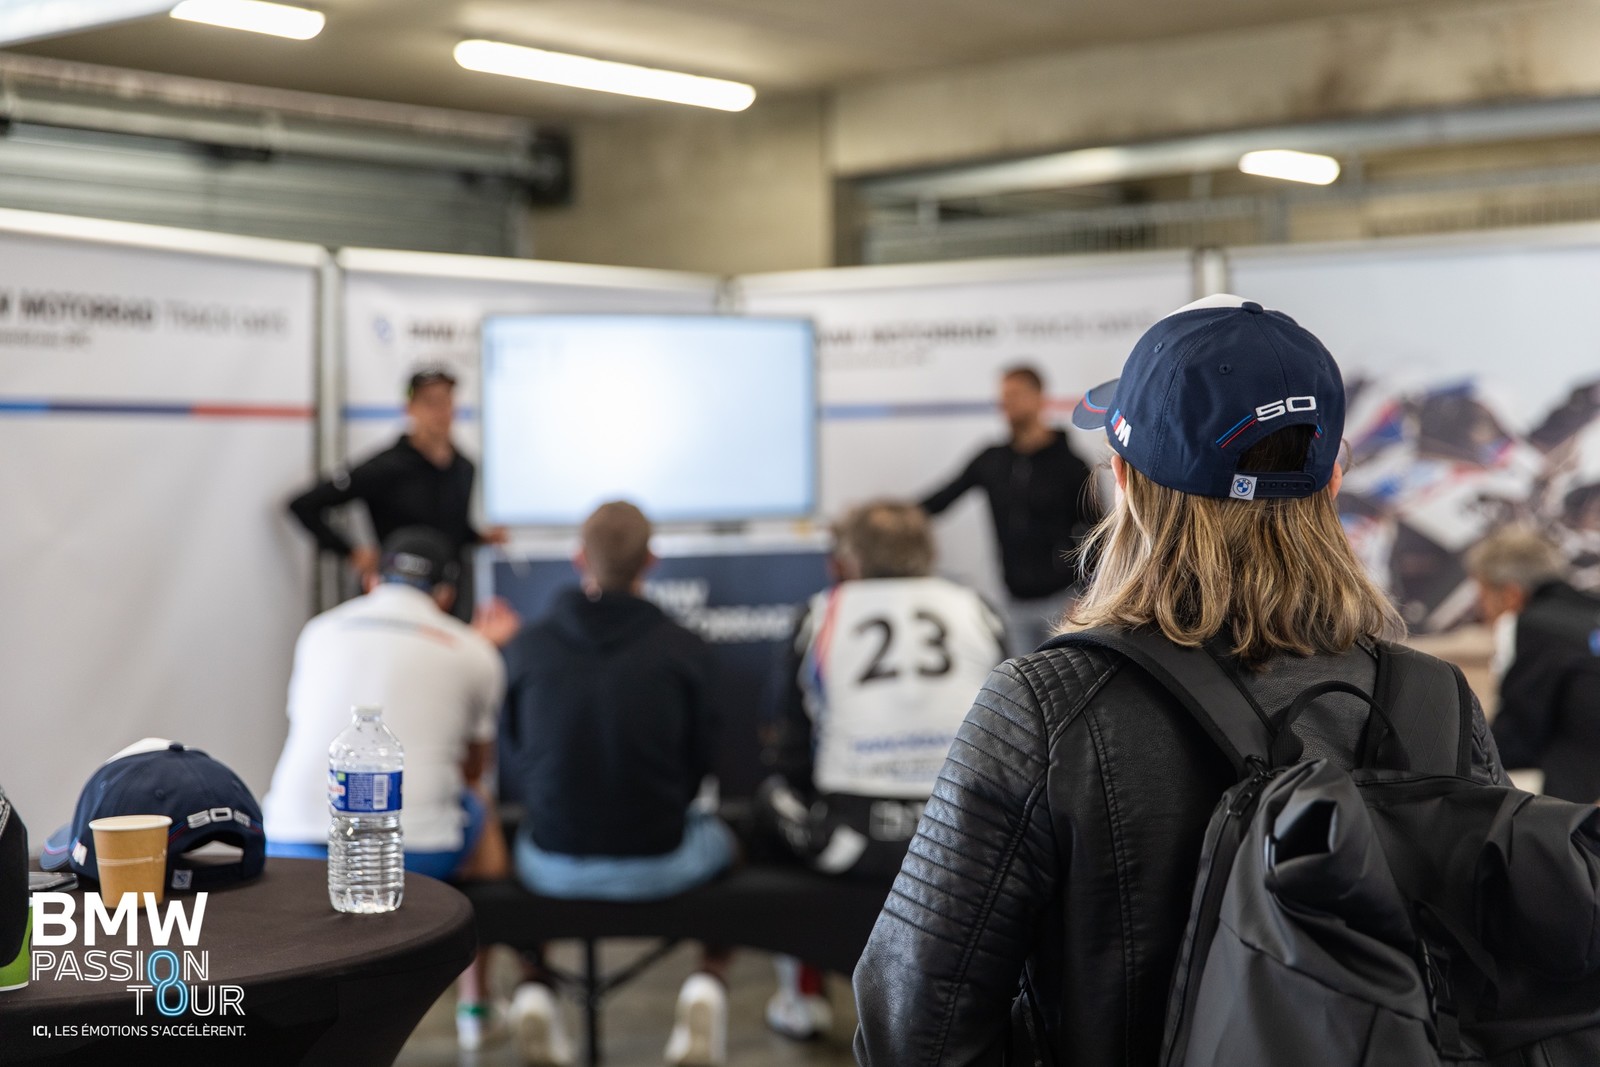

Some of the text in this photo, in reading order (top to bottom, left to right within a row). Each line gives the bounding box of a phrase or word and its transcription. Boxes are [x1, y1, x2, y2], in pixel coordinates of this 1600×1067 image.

[1255, 395, 1316, 421] 50
[1113, 415, 1132, 447] M
[856, 610, 954, 685] 23
